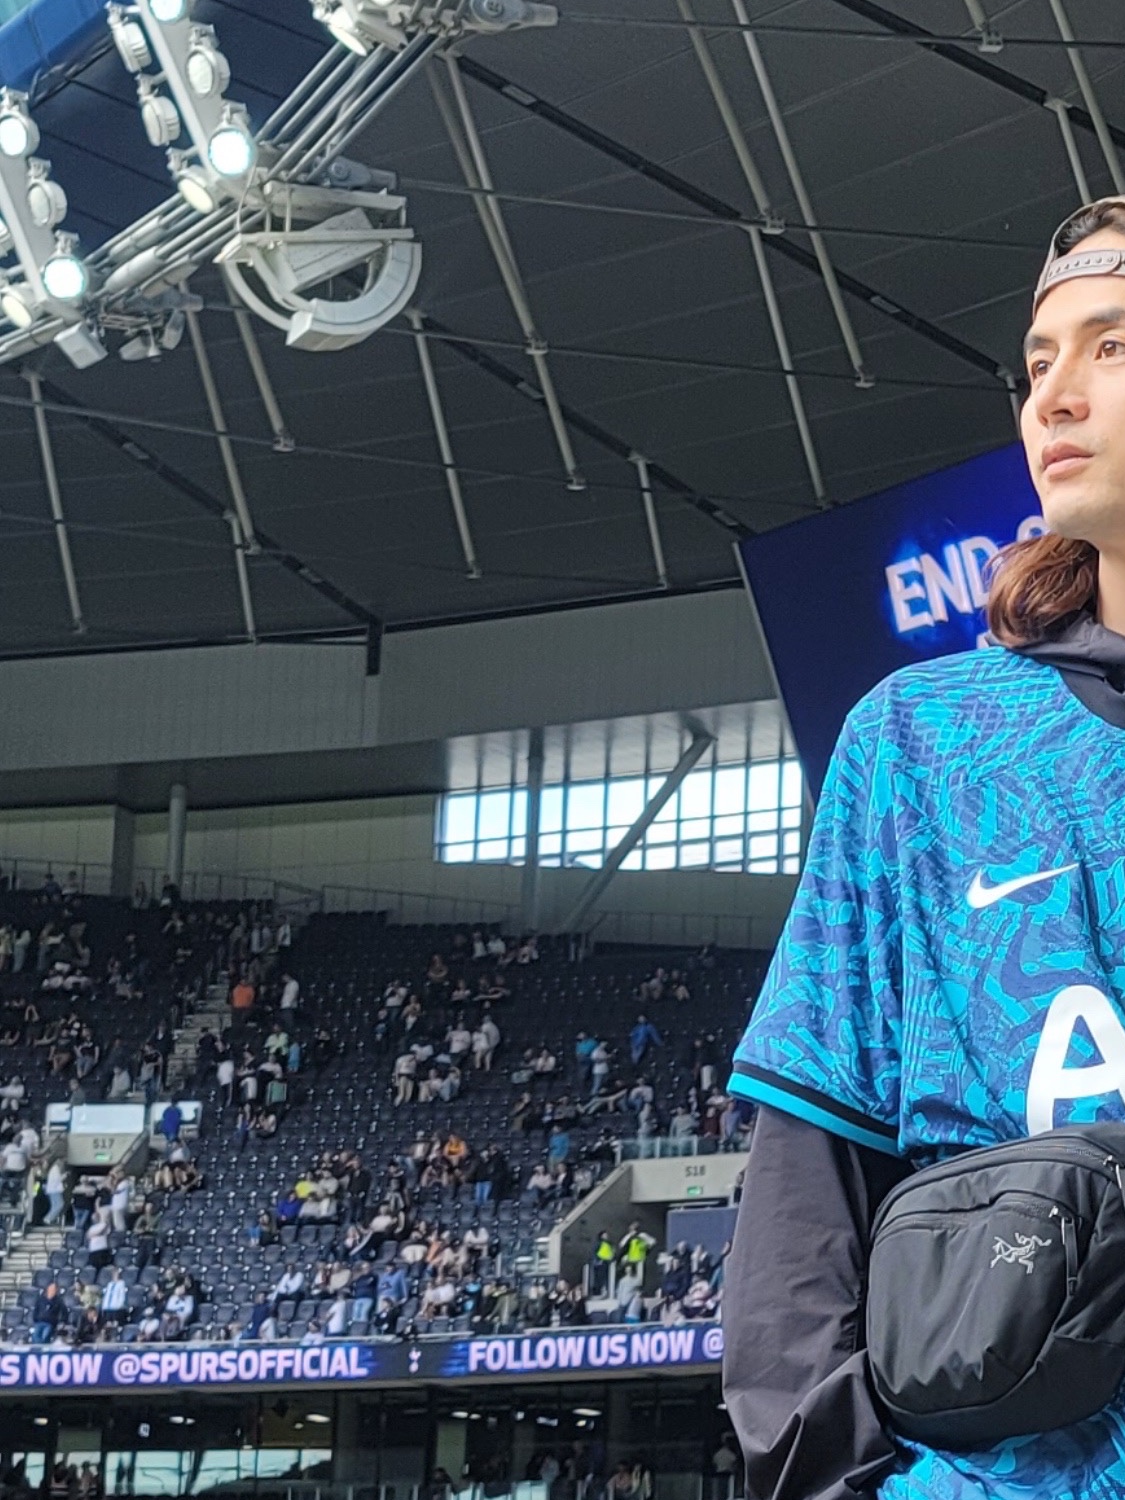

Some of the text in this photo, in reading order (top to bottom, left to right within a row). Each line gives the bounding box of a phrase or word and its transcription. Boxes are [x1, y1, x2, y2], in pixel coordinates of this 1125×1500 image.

[885, 536, 1003, 633] END
[0, 1347, 368, 1385] S NOW @SPURSOFFICIAL
[468, 1337, 587, 1372] FOLLOW
[587, 1334, 628, 1367] US
[630, 1329, 695, 1363] NOW
